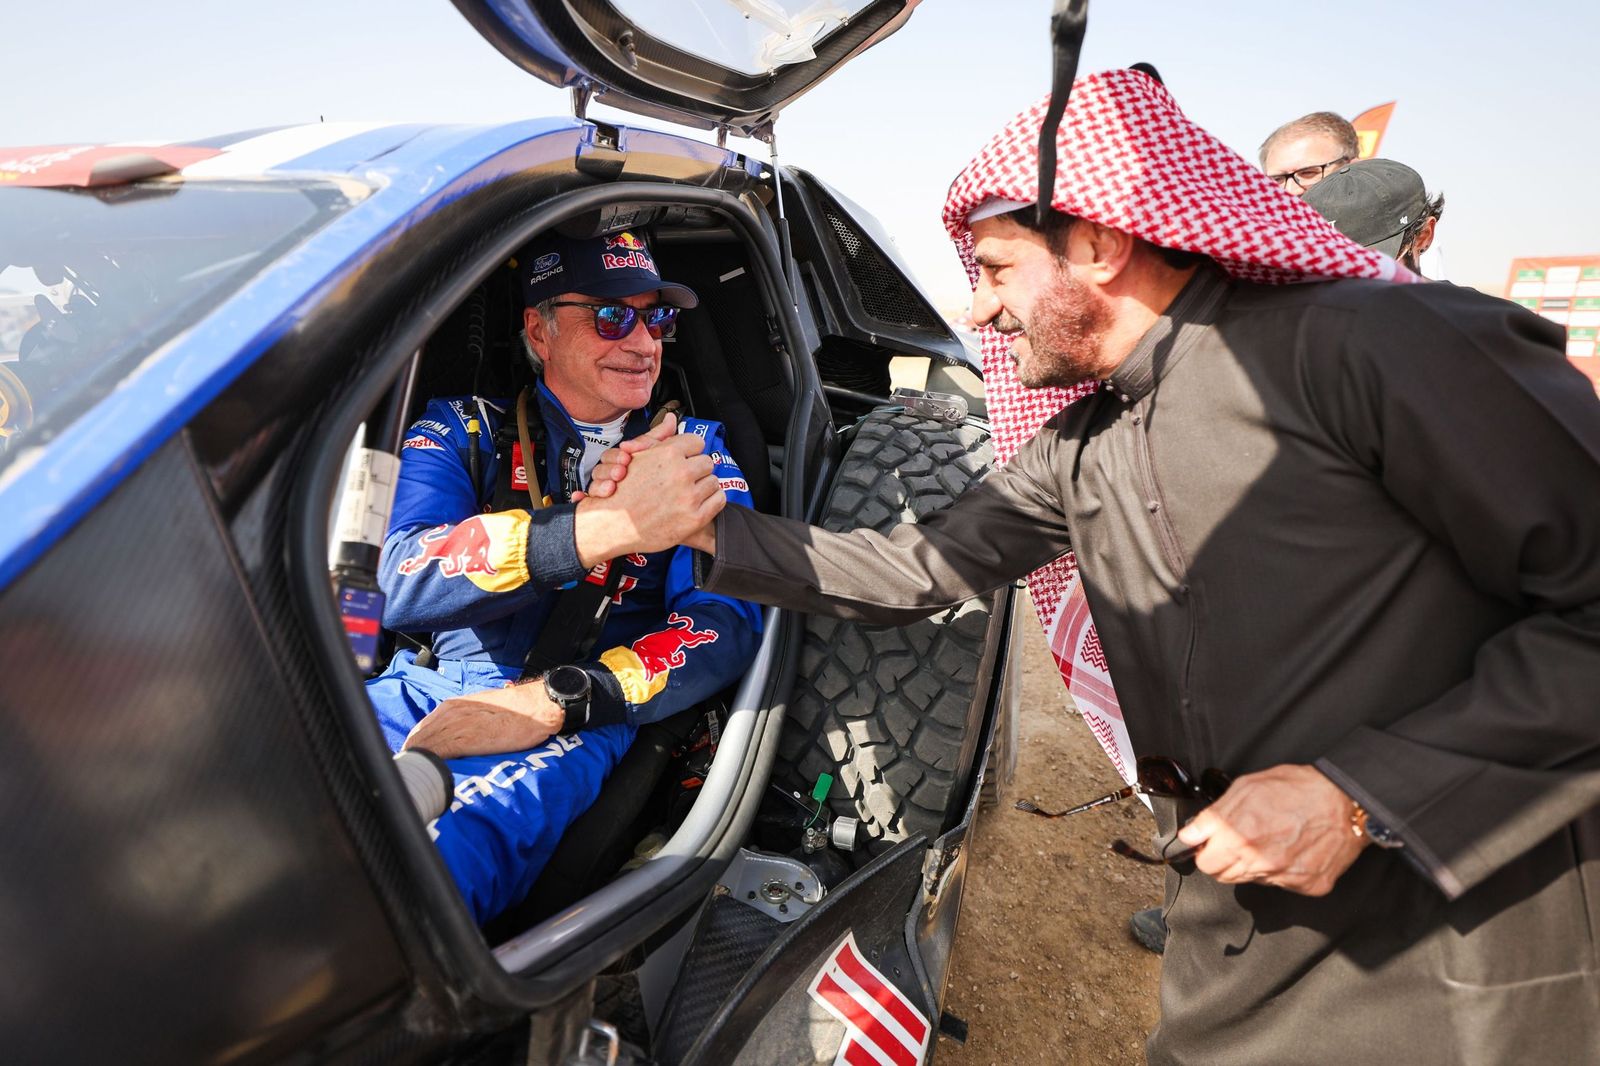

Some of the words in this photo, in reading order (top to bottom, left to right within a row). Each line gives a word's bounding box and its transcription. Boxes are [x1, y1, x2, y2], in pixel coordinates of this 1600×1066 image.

[534, 254, 555, 270] Ford
[601, 251, 638, 270] Red
[637, 252, 658, 276] Bu
[530, 265, 564, 286] RACING
[583, 434, 610, 447] AINZ
